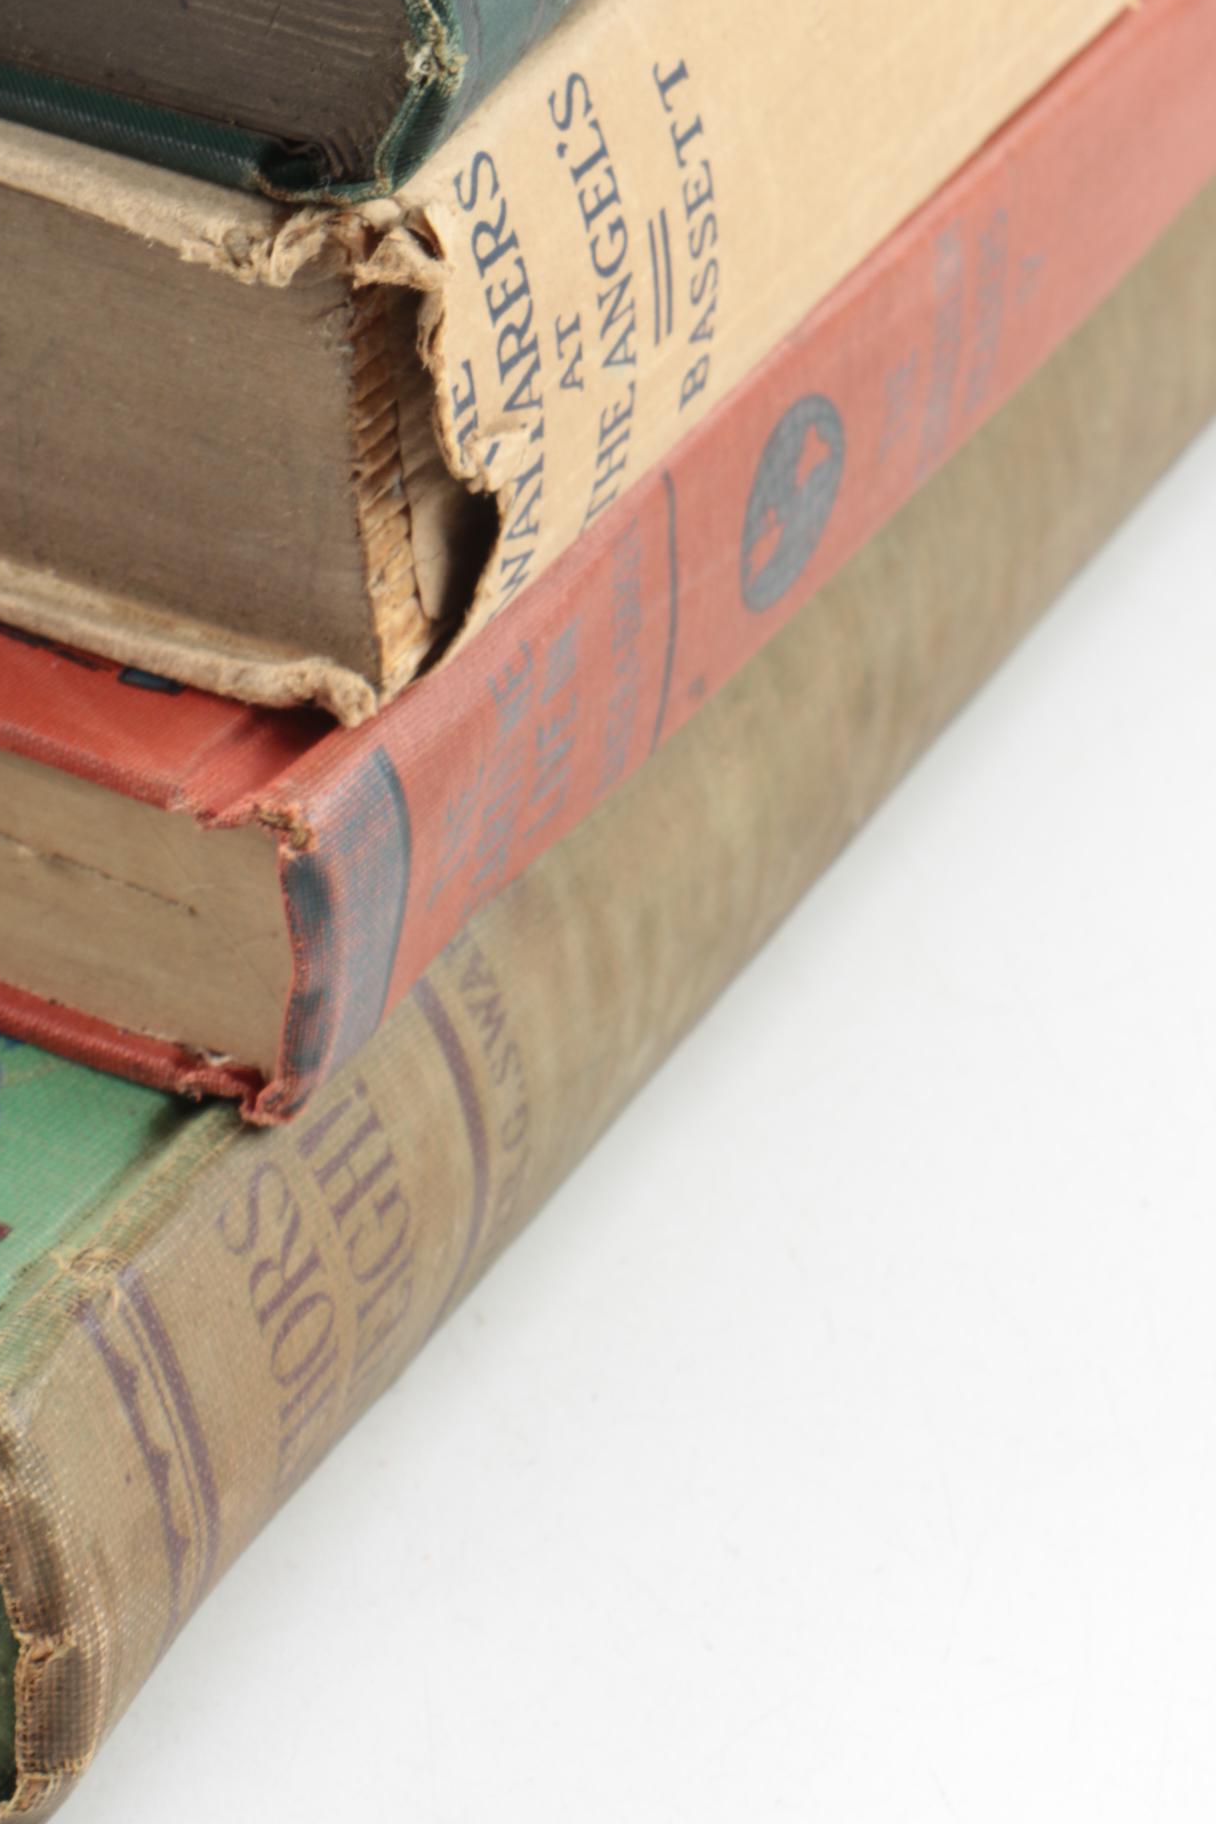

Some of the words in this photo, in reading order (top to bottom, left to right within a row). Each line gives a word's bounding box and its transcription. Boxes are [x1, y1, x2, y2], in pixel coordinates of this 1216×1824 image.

[547, 71, 637, 369] ANGEL'S
[555, 311, 584, 391] AT
[651, 57, 718, 412] BASSETT
[452, 150, 544, 622] WAYARERS
[584, 380, 637, 526] THE
